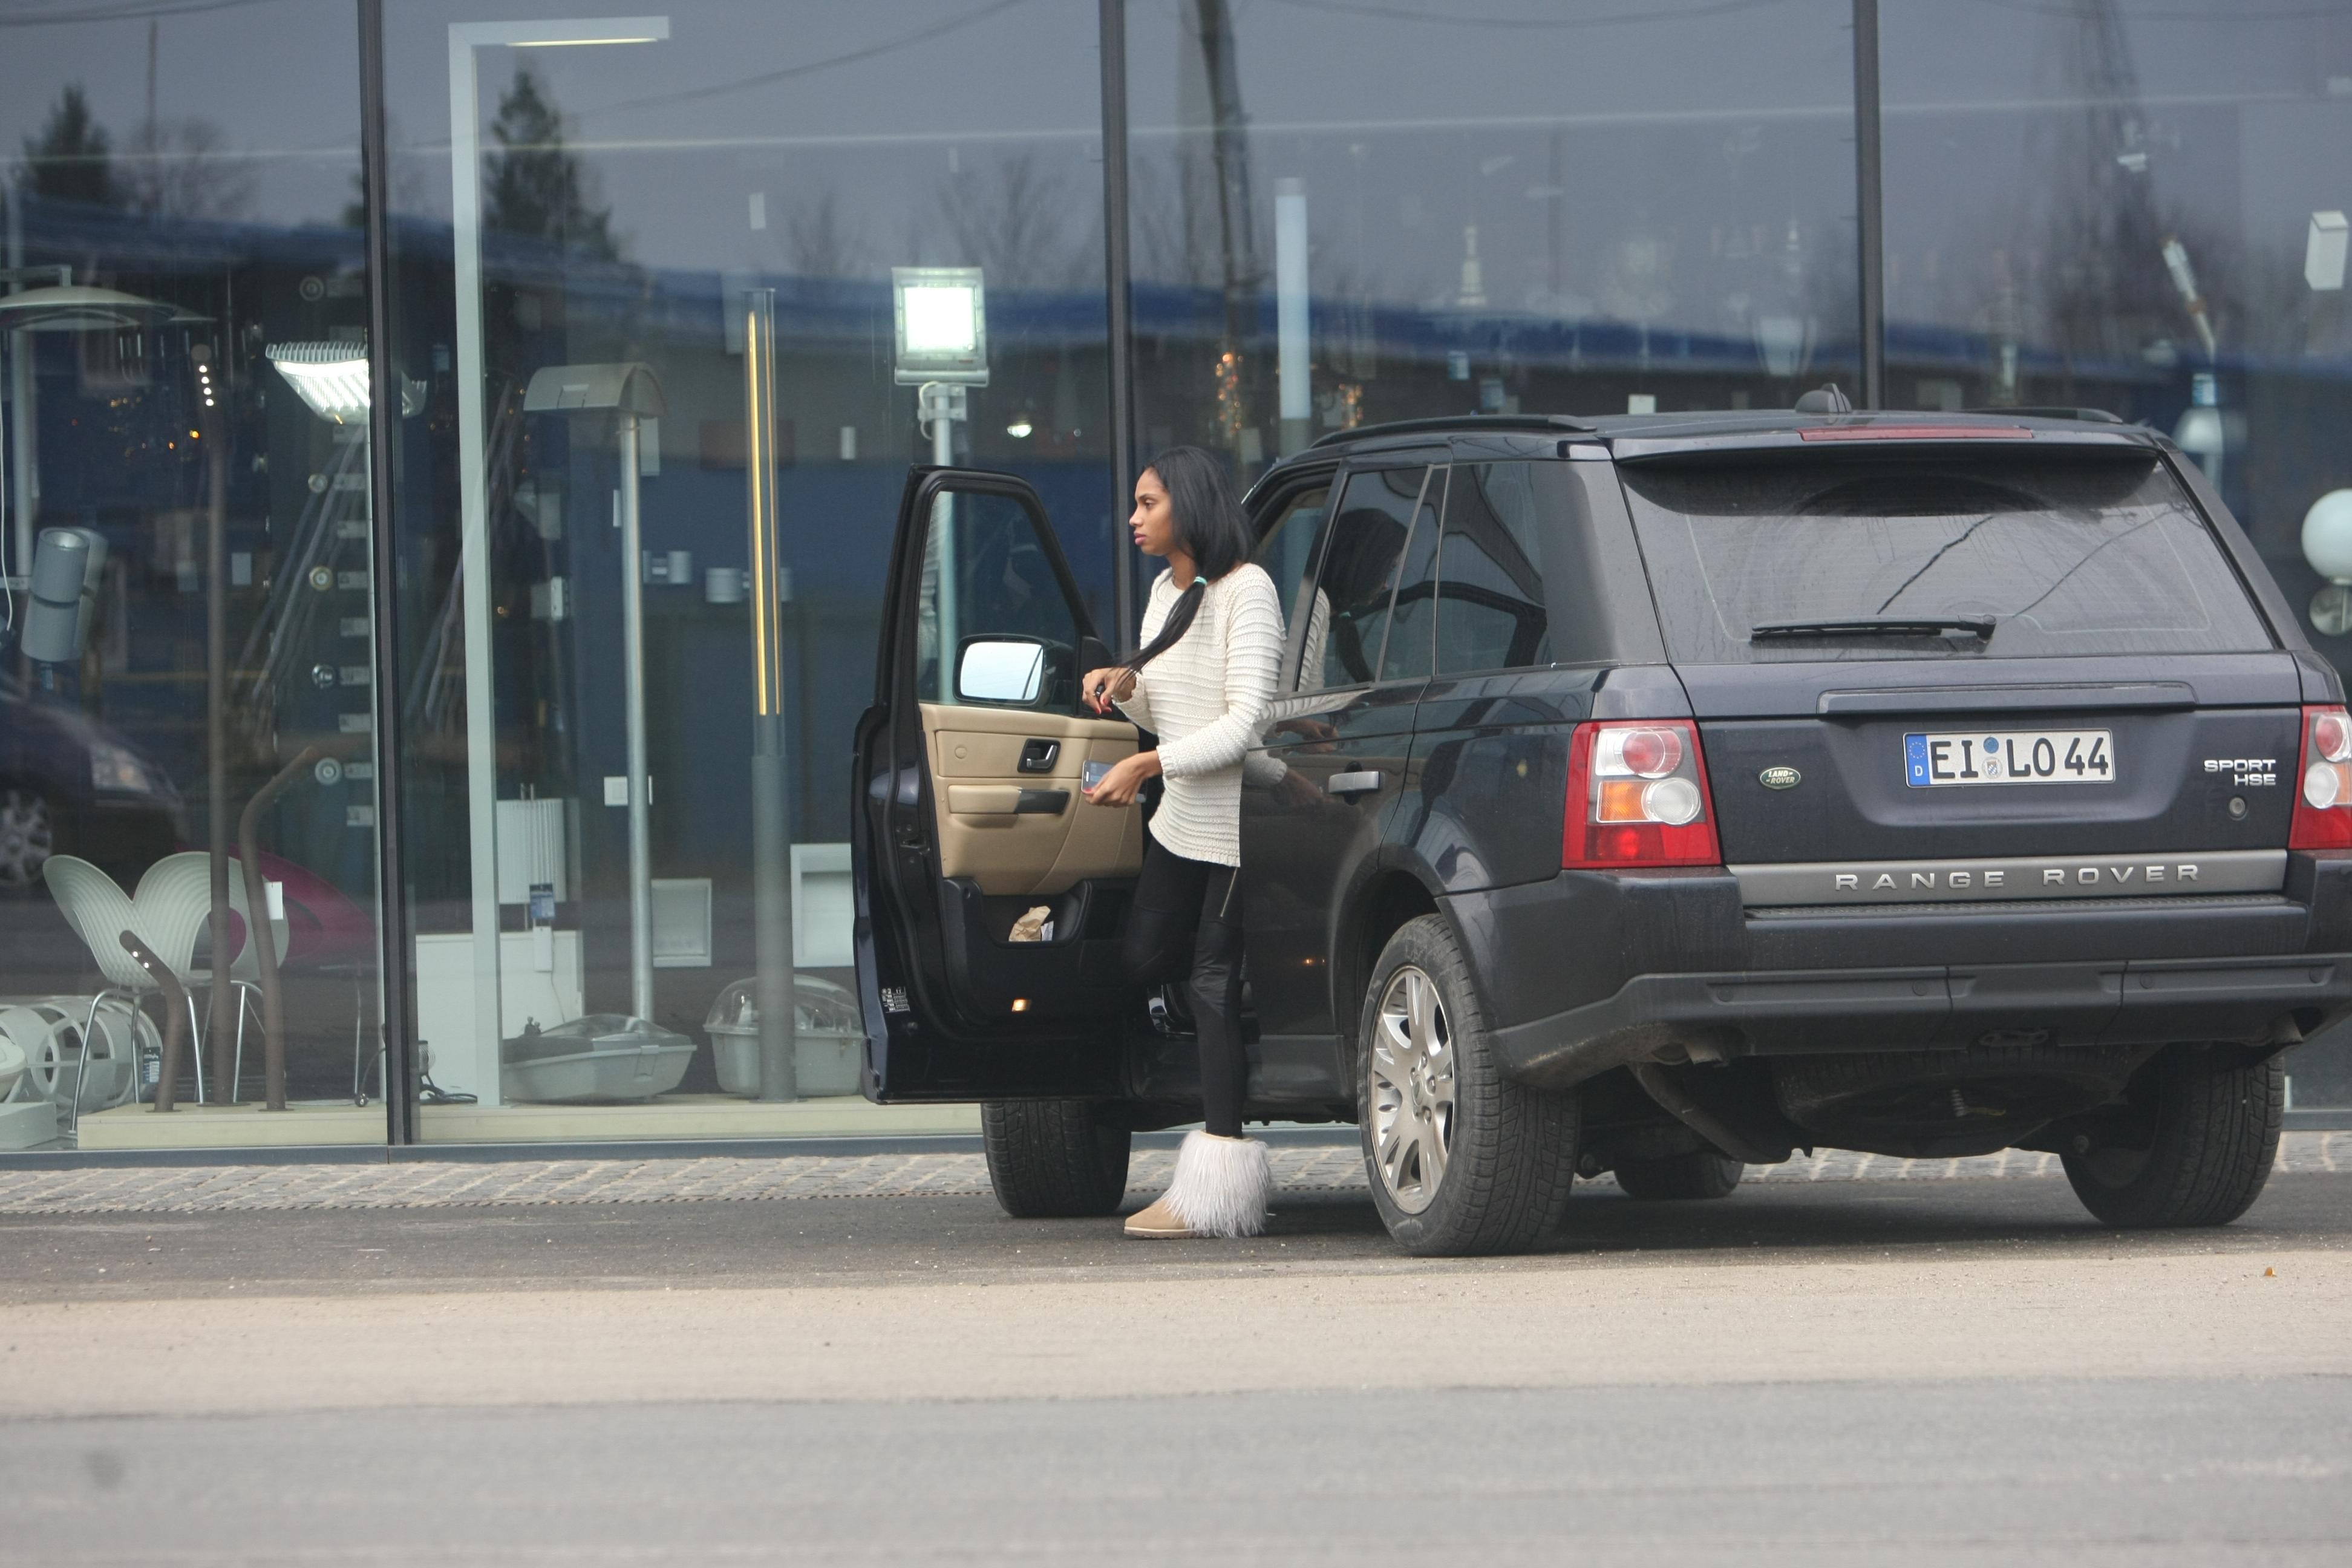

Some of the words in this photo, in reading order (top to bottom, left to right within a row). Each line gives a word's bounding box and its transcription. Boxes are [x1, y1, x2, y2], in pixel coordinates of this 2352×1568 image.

[1930, 740, 1979, 779] EI
[2204, 759, 2276, 773] SPORT
[1914, 765, 1924, 777] D
[2233, 774, 2276, 786] HSE
[1835, 871, 2005, 891] RANGE
[2043, 864, 2198, 886] ROVER
